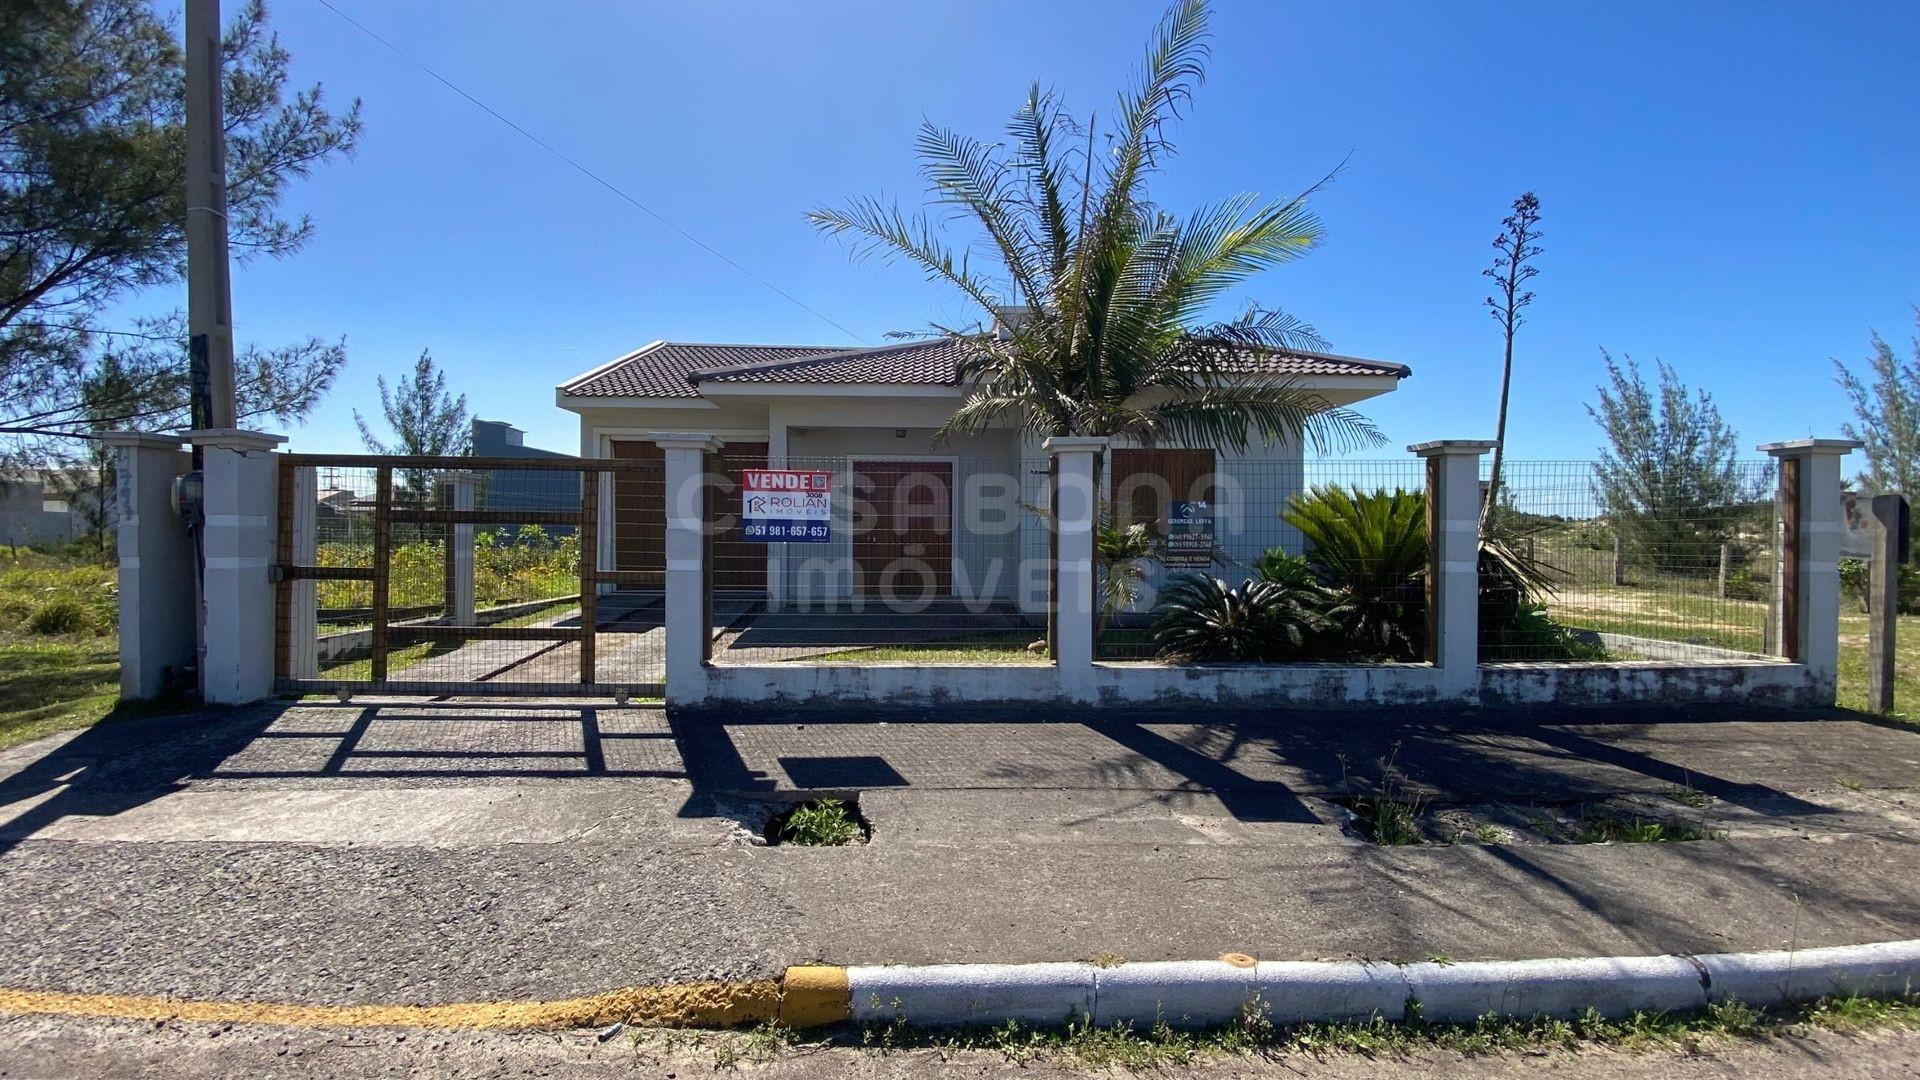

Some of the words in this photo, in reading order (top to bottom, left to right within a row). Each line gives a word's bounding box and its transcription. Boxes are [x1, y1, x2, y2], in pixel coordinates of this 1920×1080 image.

[747, 473, 810, 490] VENDE
[770, 496, 827, 508] ROLIAN
[770, 507, 827, 516] IMÓVEIS
[755, 525, 766, 536] 51
[769, 525, 828, 537] 981-657-657
